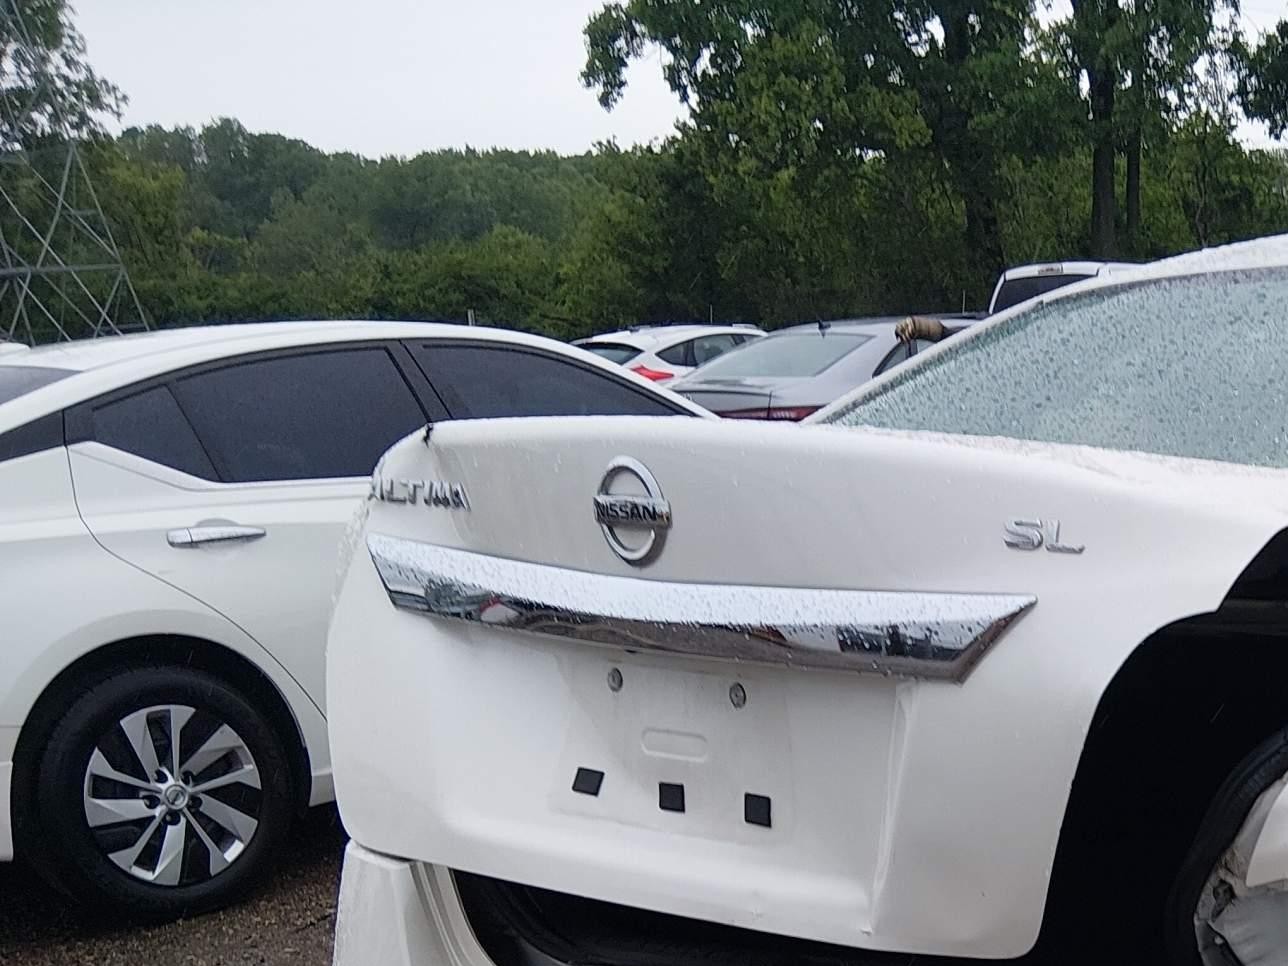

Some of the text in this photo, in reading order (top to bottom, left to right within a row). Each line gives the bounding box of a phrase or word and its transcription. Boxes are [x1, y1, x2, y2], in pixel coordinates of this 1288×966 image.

[368, 478, 471, 512] ALTIMA
[594, 500, 657, 521] NISSAN
[1003, 517, 1085, 553] SL
